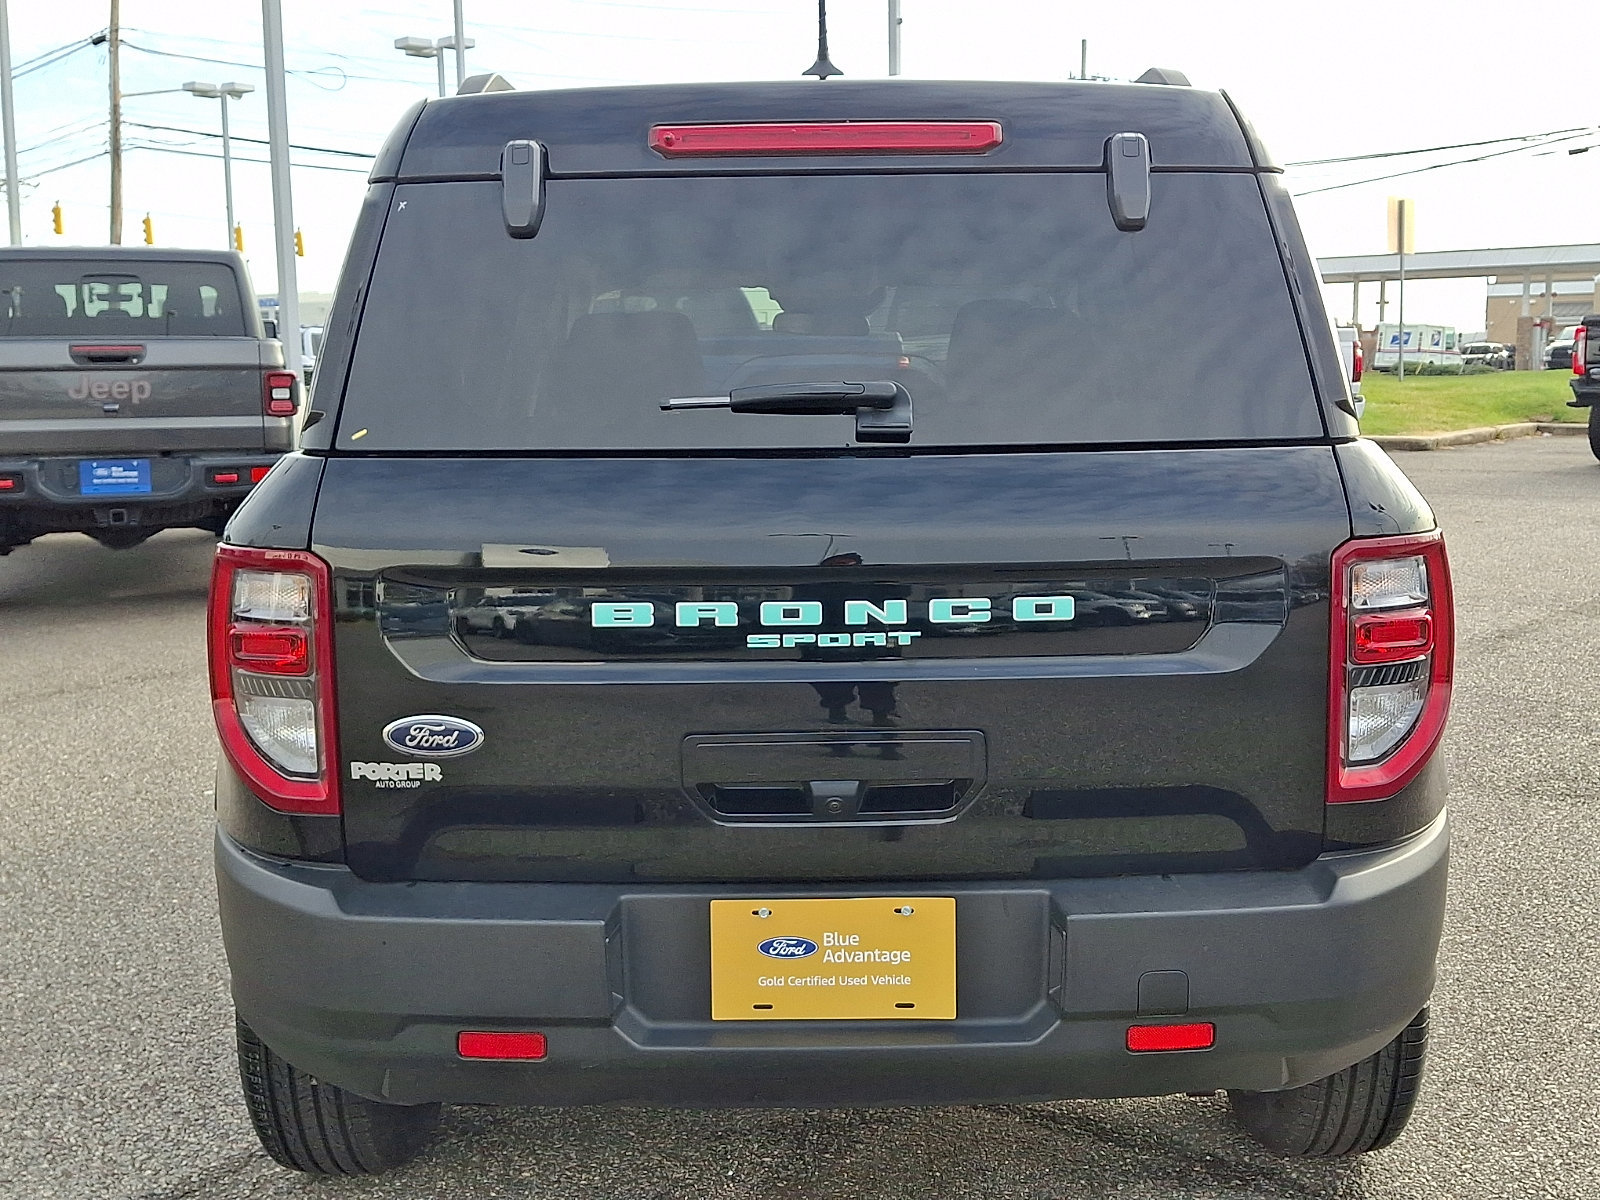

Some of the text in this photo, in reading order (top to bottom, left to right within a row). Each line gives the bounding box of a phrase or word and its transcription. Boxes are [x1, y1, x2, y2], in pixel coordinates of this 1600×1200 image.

[68, 374, 152, 404] Jeep
[591, 595, 1076, 628] BRONCO
[746, 630, 922, 649] SPORT
[405, 724, 460, 748] Ford
[350, 761, 444, 782] PORTER
[375, 780, 421, 789] AUTO GROUP
[768, 940, 807, 956] Ford
[823, 932, 860, 947] Blue
[823, 948, 911, 965] Advantage
[758, 974, 911, 987] Gold Certified Used Vehicle
